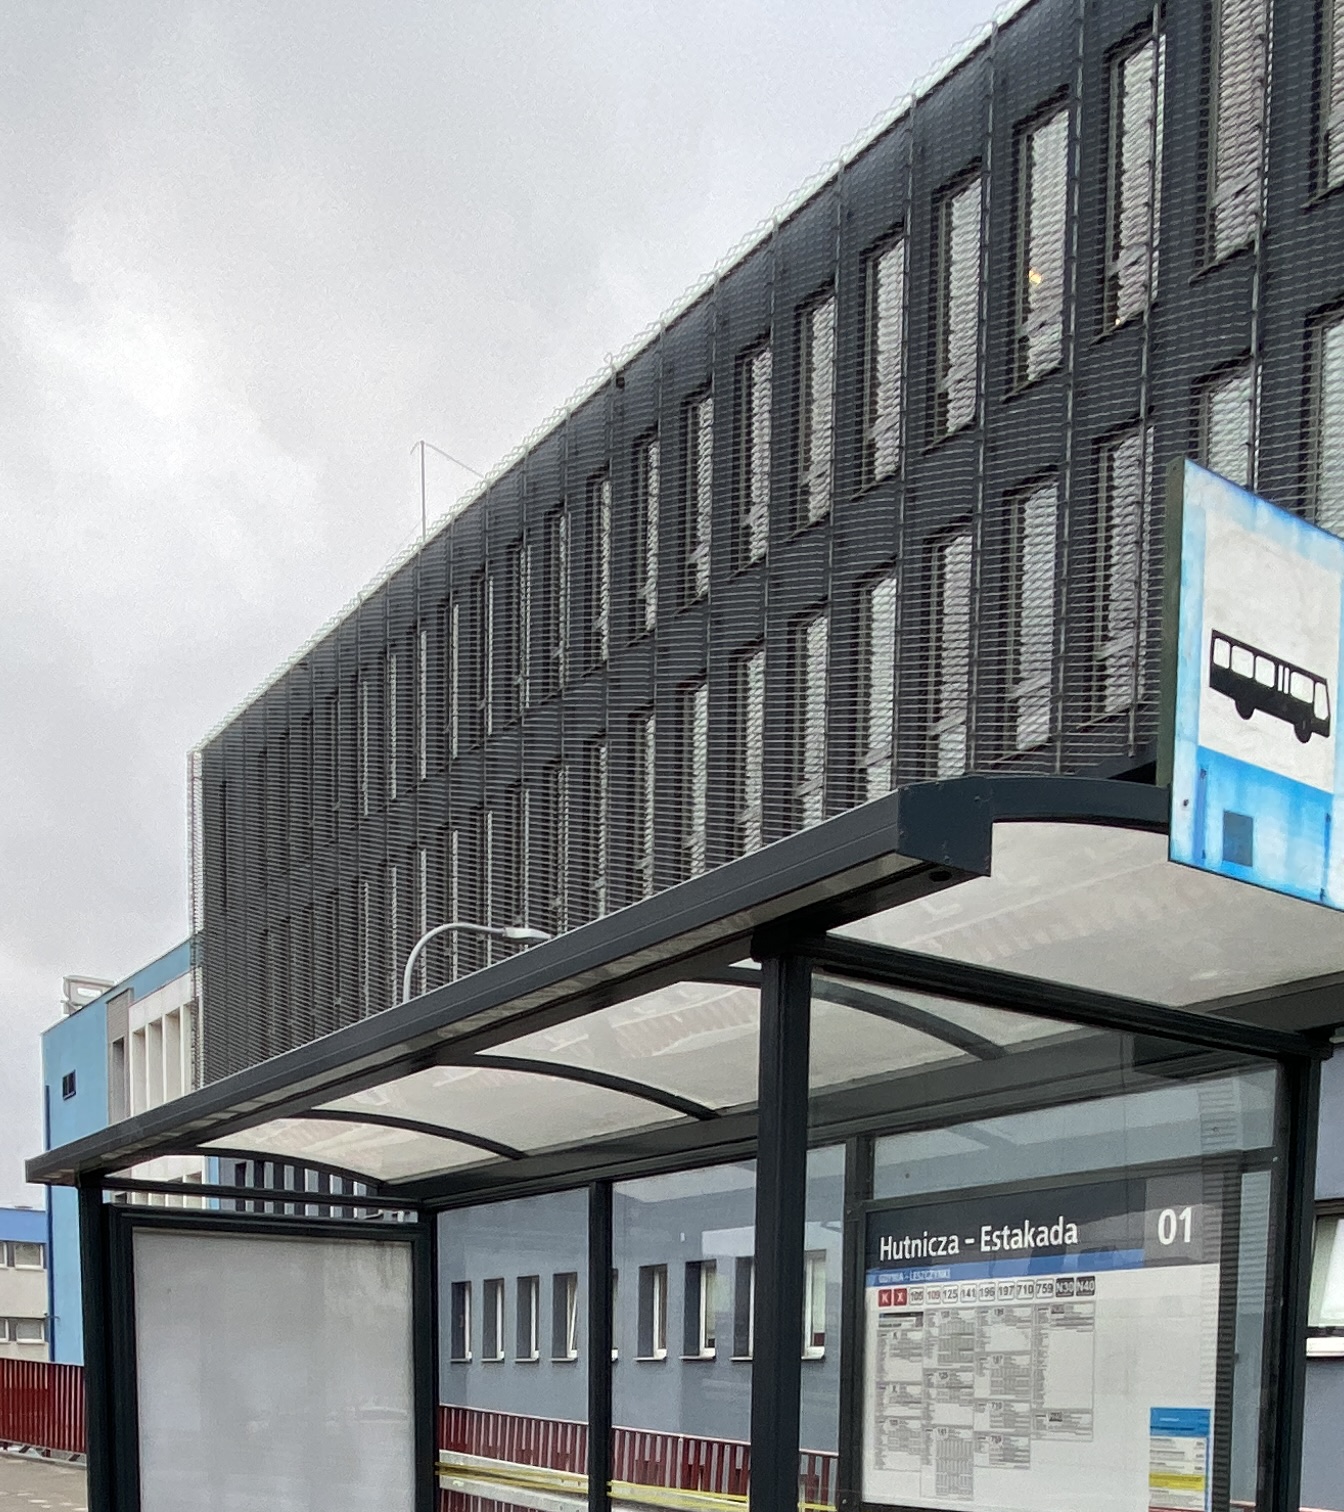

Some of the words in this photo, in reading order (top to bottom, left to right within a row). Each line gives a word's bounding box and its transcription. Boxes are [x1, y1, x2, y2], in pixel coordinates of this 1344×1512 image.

[879, 1231, 959, 1261] Hutnicza
[980, 1216, 1078, 1252] Estakada
[1158, 1206, 1192, 1245] 01
[943, 1288, 958, 1299] 125
[960, 1287, 976, 1298] 141
[998, 1285, 1014, 1296] 197
[1016, 1284, 1034, 1295] 710
[1036, 1283, 1054, 1294] 759
[1056, 1281, 1074, 1293] N30
[1076, 1280, 1095, 1291] N40
